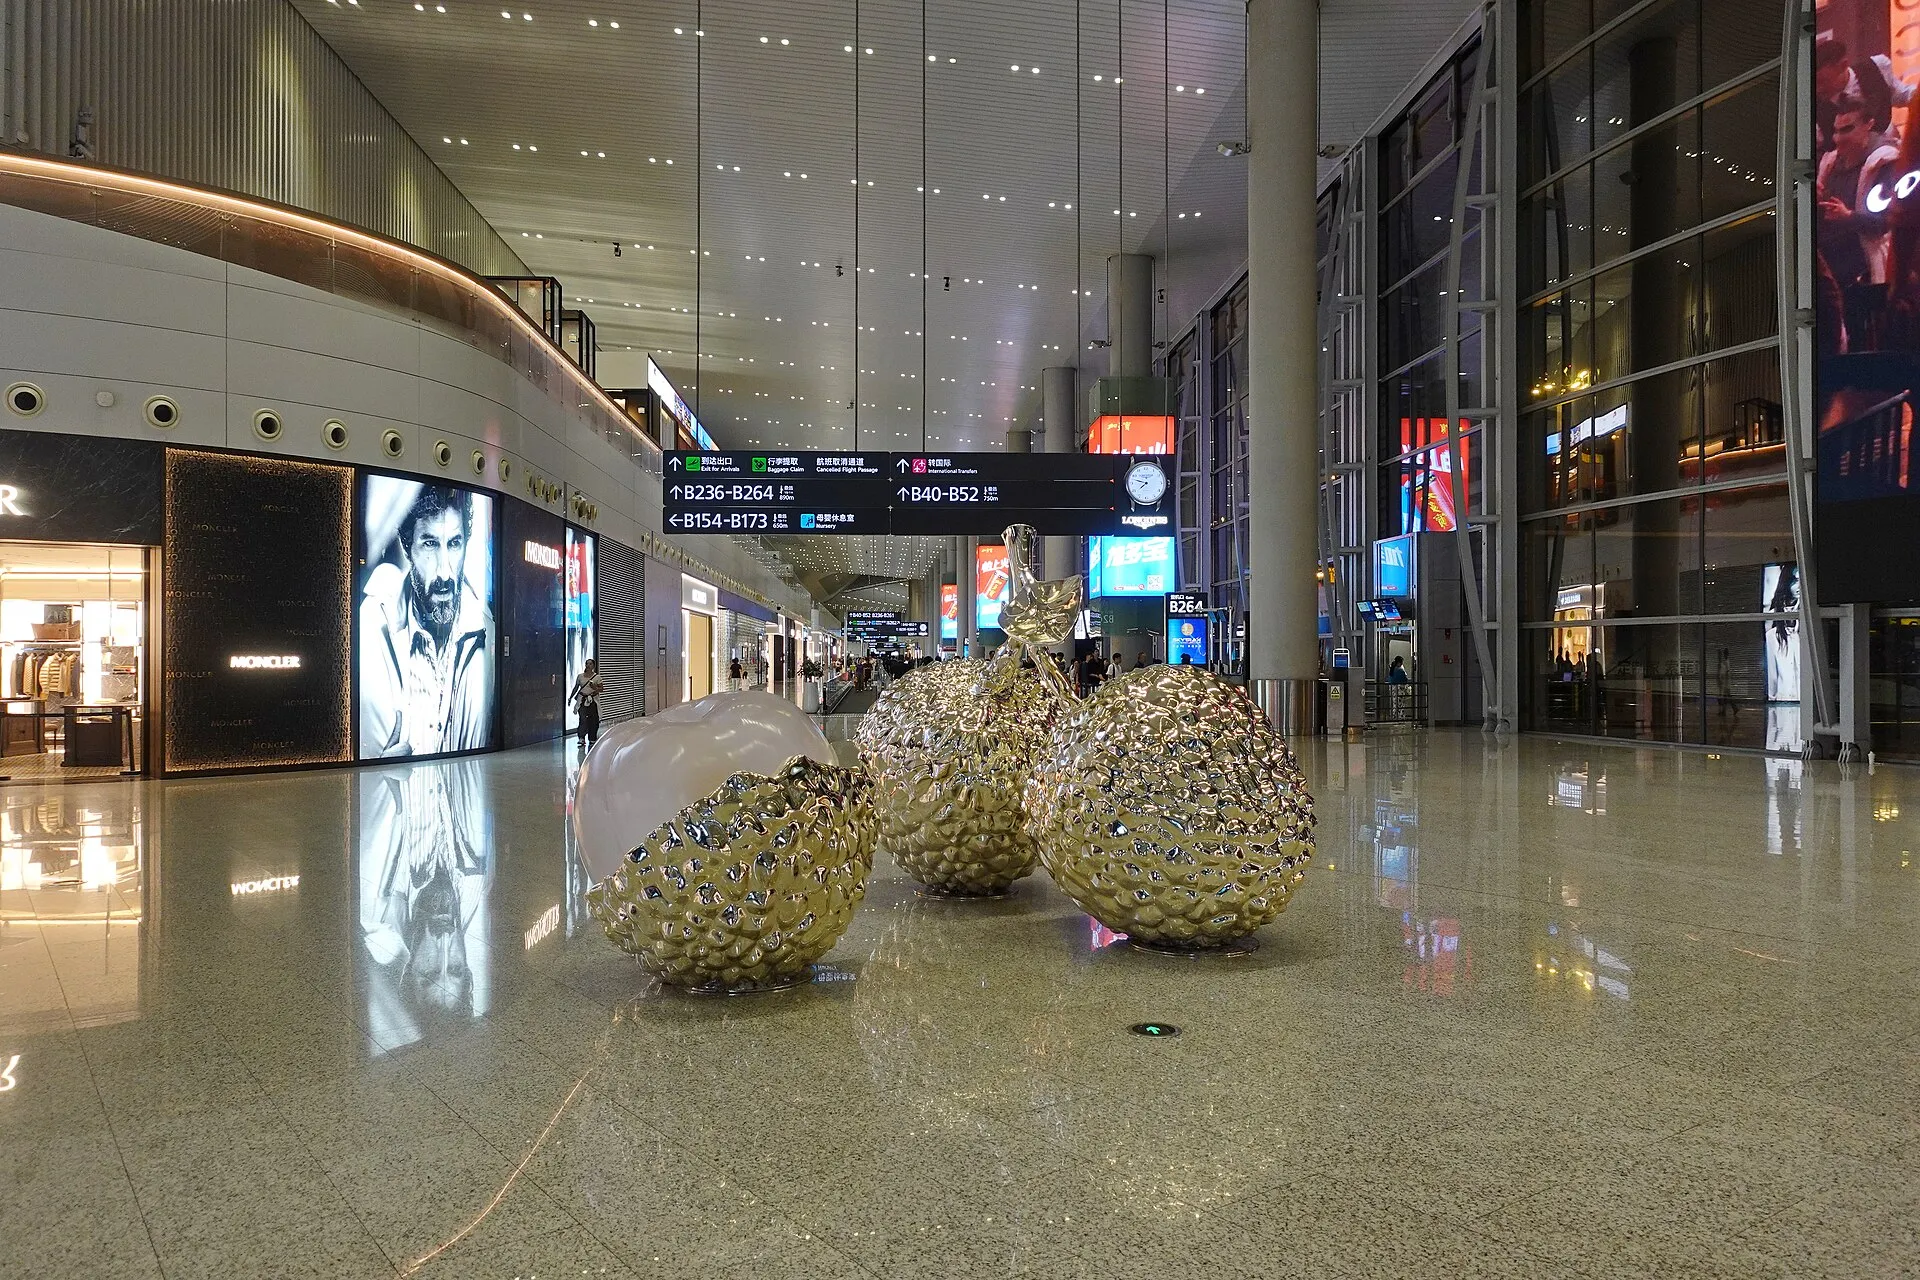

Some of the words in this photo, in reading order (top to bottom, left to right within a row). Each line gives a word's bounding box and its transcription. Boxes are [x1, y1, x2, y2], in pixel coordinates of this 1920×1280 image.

[701, 457, 732, 465] 到达出口
[767, 457, 799, 466] 行李提取
[816, 457, 864, 466] 航班取消通道
[928, 459, 951, 467] 转国际
[684, 485, 774, 501] B236-B264
[911, 487, 979, 501] B40-B52
[684, 513, 767, 528] B154-B173
[816, 513, 855, 522] 母婴休息室
[1122, 516, 1168, 525] LONGINES
[1169, 600, 1204, 614] B264
[230, 656, 300, 669] MONCLER
